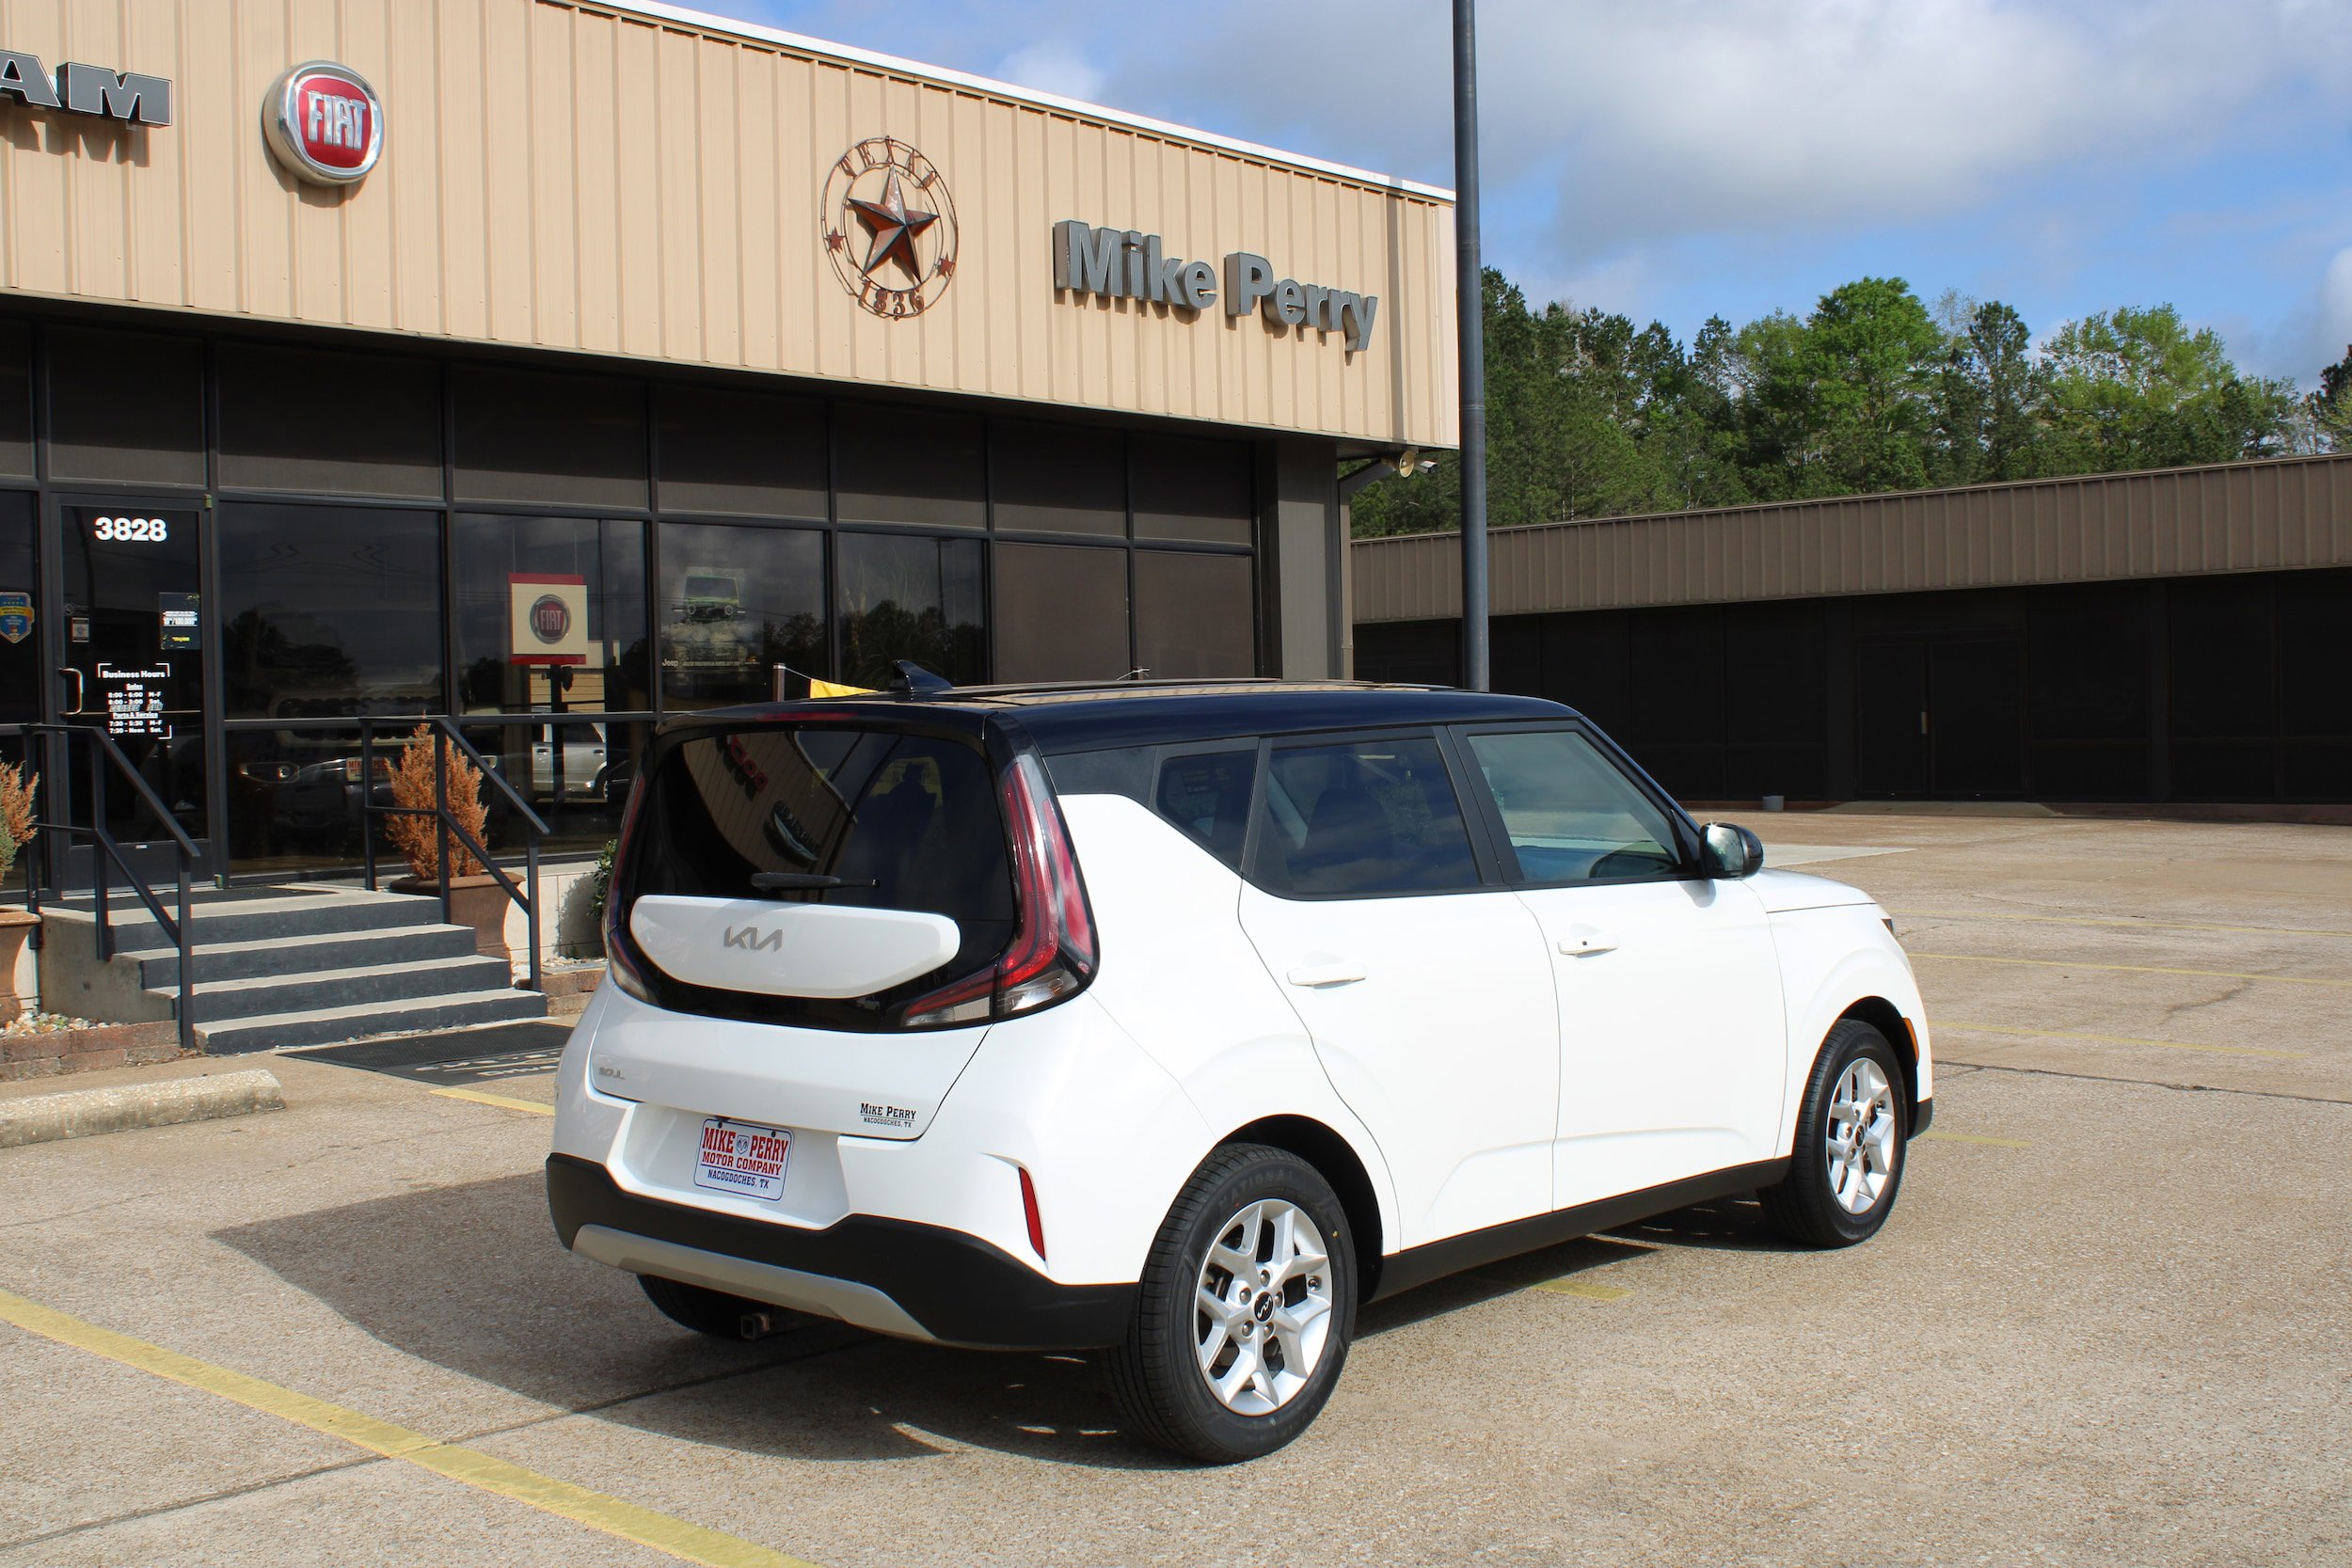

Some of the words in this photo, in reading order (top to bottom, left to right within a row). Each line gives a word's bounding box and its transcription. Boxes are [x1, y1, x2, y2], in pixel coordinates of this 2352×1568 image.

[0, 49, 172, 129] AM
[308, 91, 367, 150] FIAT
[836, 137, 940, 192] TEXAS
[857, 279, 925, 317] 1836
[1054, 220, 1217, 309] Mike
[1226, 251, 1378, 352] Perry
[95, 516, 167, 542] 3828
[539, 609, 563, 631] FIAT
[102, 670, 139, 678] Business
[140, 670, 166, 678] Hours
[661, 658, 678, 668] Jeep
[702, 1127, 737, 1154] MIKE
[749, 1134, 789, 1163] PERRY
[702, 1150, 734, 1167] MOTOR
[737, 1157, 782, 1176] COMPANY
[707, 1168, 757, 1187] NACOGDOCHES,
[760, 1179, 770, 1189] TX
